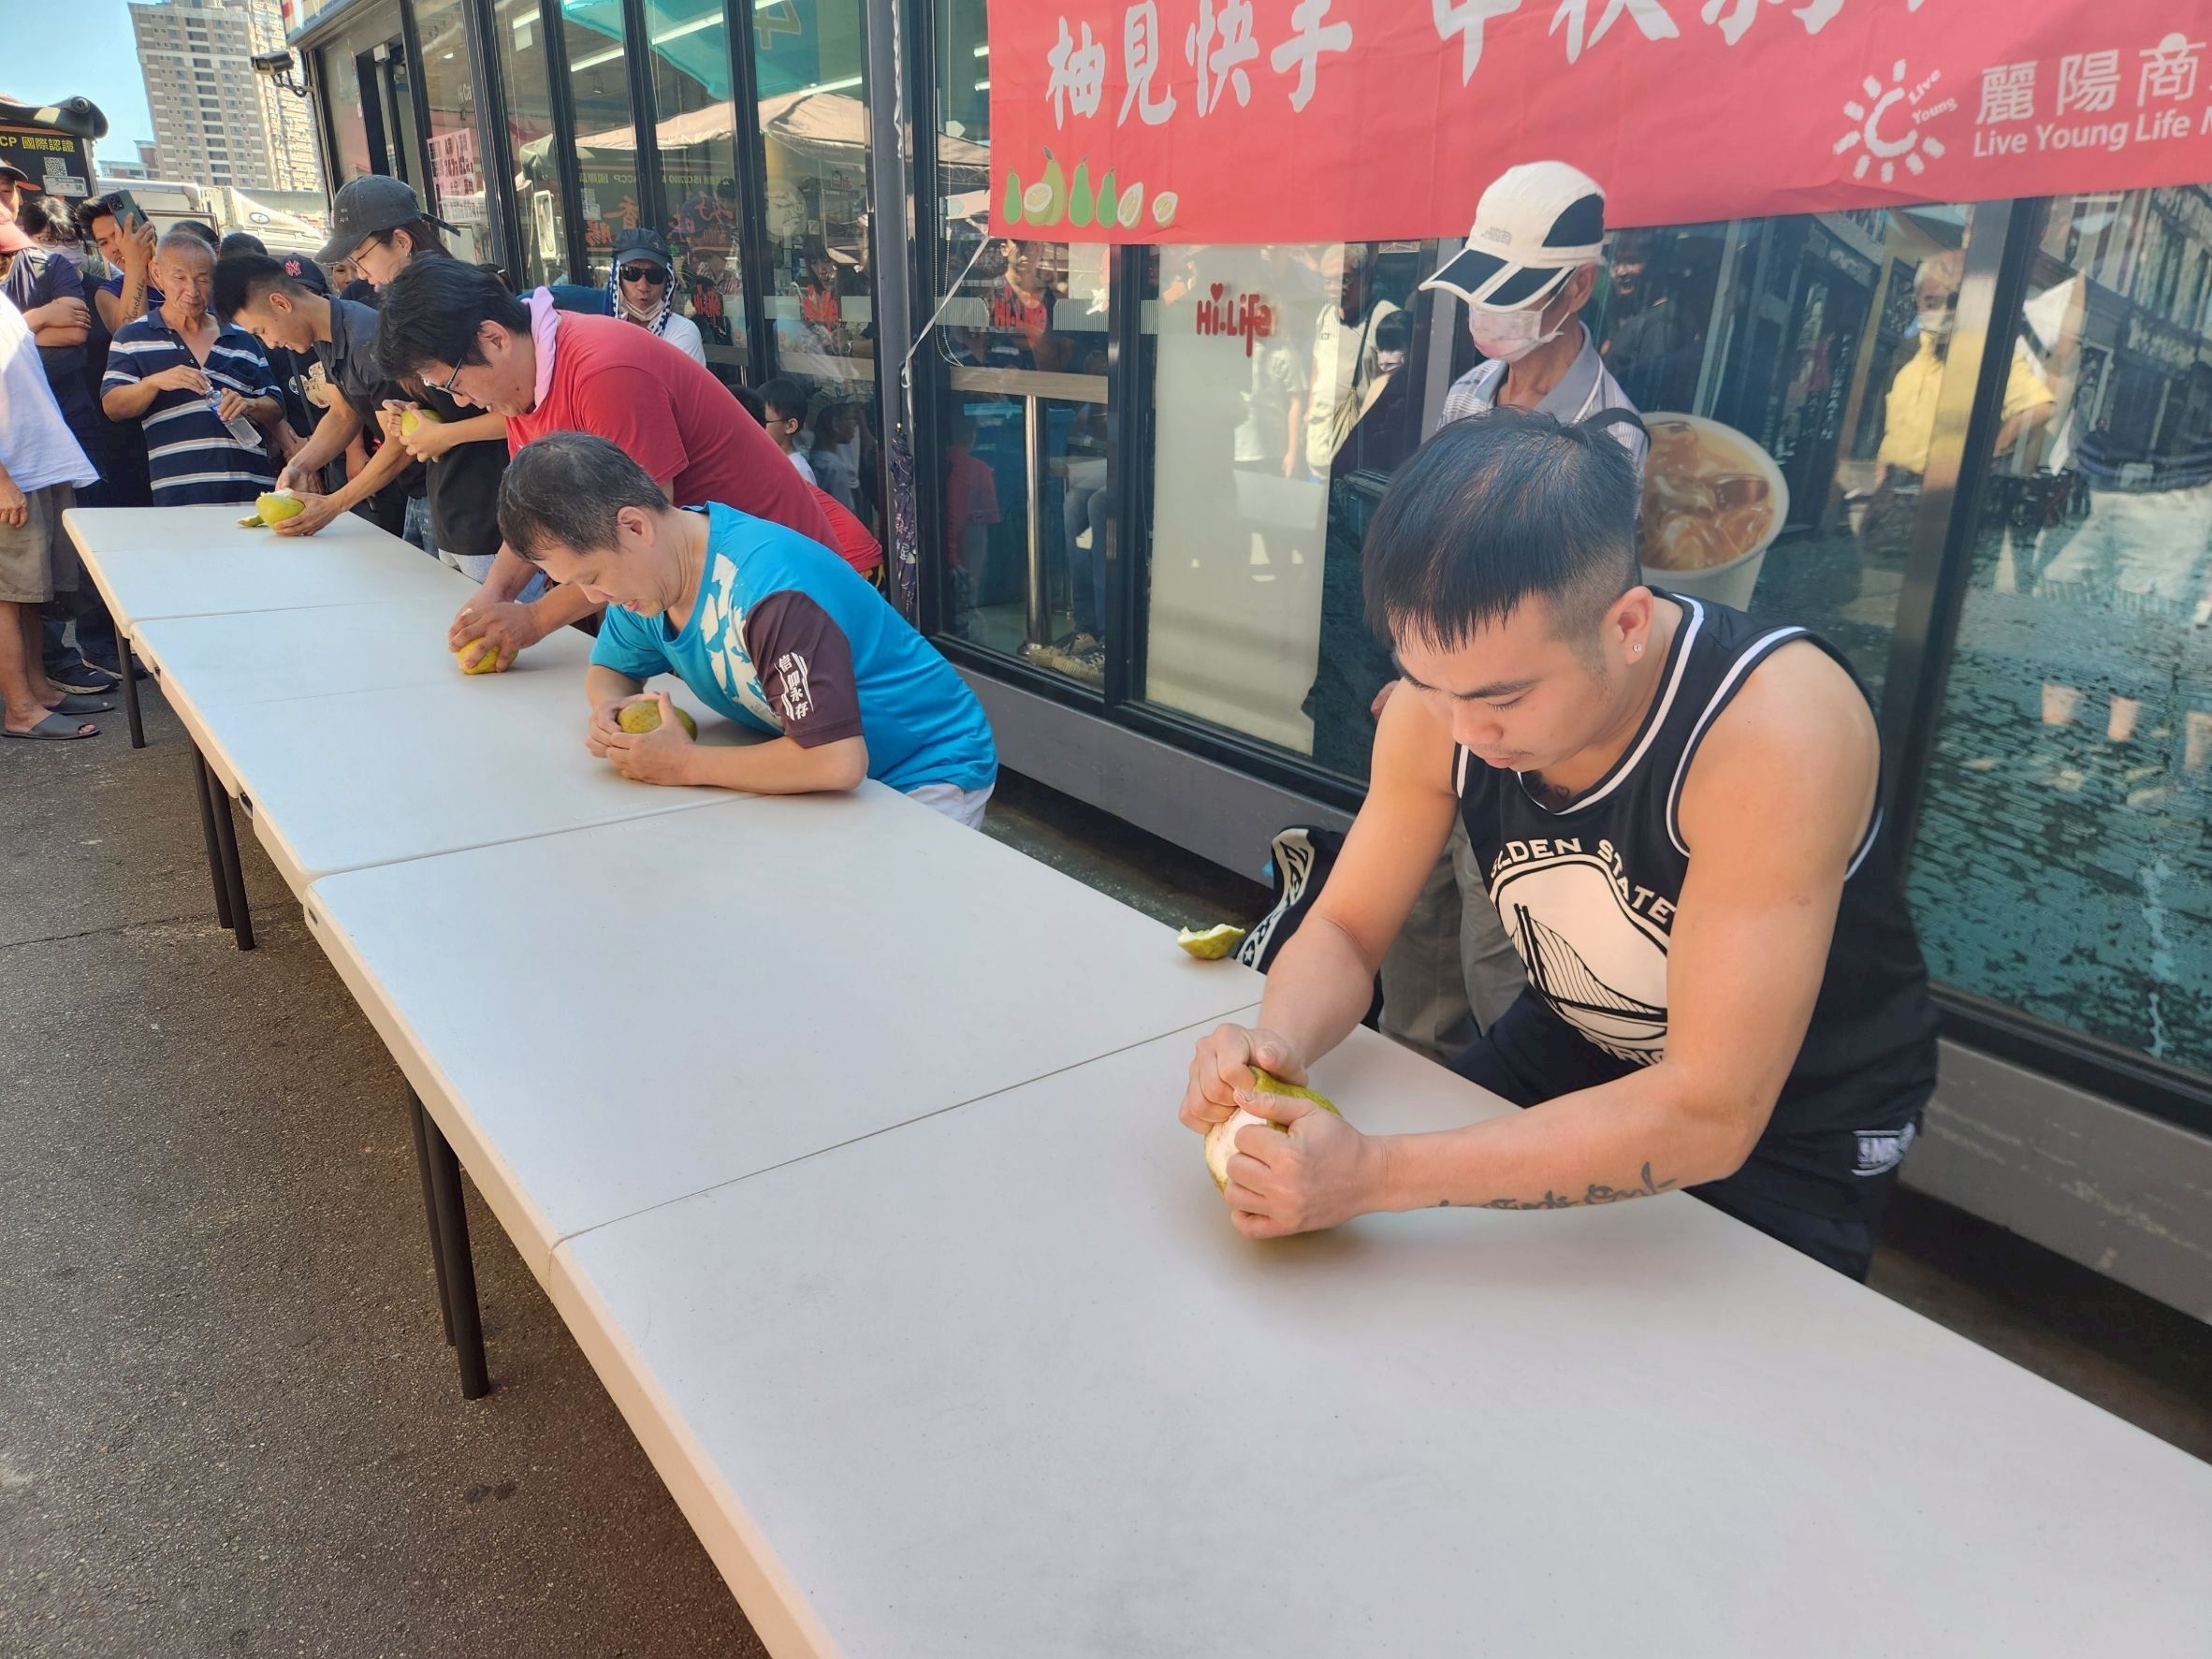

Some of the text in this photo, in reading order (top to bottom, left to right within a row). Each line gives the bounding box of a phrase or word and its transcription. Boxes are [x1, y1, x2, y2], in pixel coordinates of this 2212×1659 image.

[1045, 0, 1353, 131] 柚見快手
[1909, 70, 1941, 105] Live
[1975, 33, 2212, 125] 麗陽商
[1912, 97, 1958, 124] Young
[1973, 130, 2028, 157] Live
[2035, 123, 2130, 152] Young
[2134, 109, 2191, 141] Life
[22, 137, 75, 152] 國際認證
[1597, 838, 1677, 925] STATE
